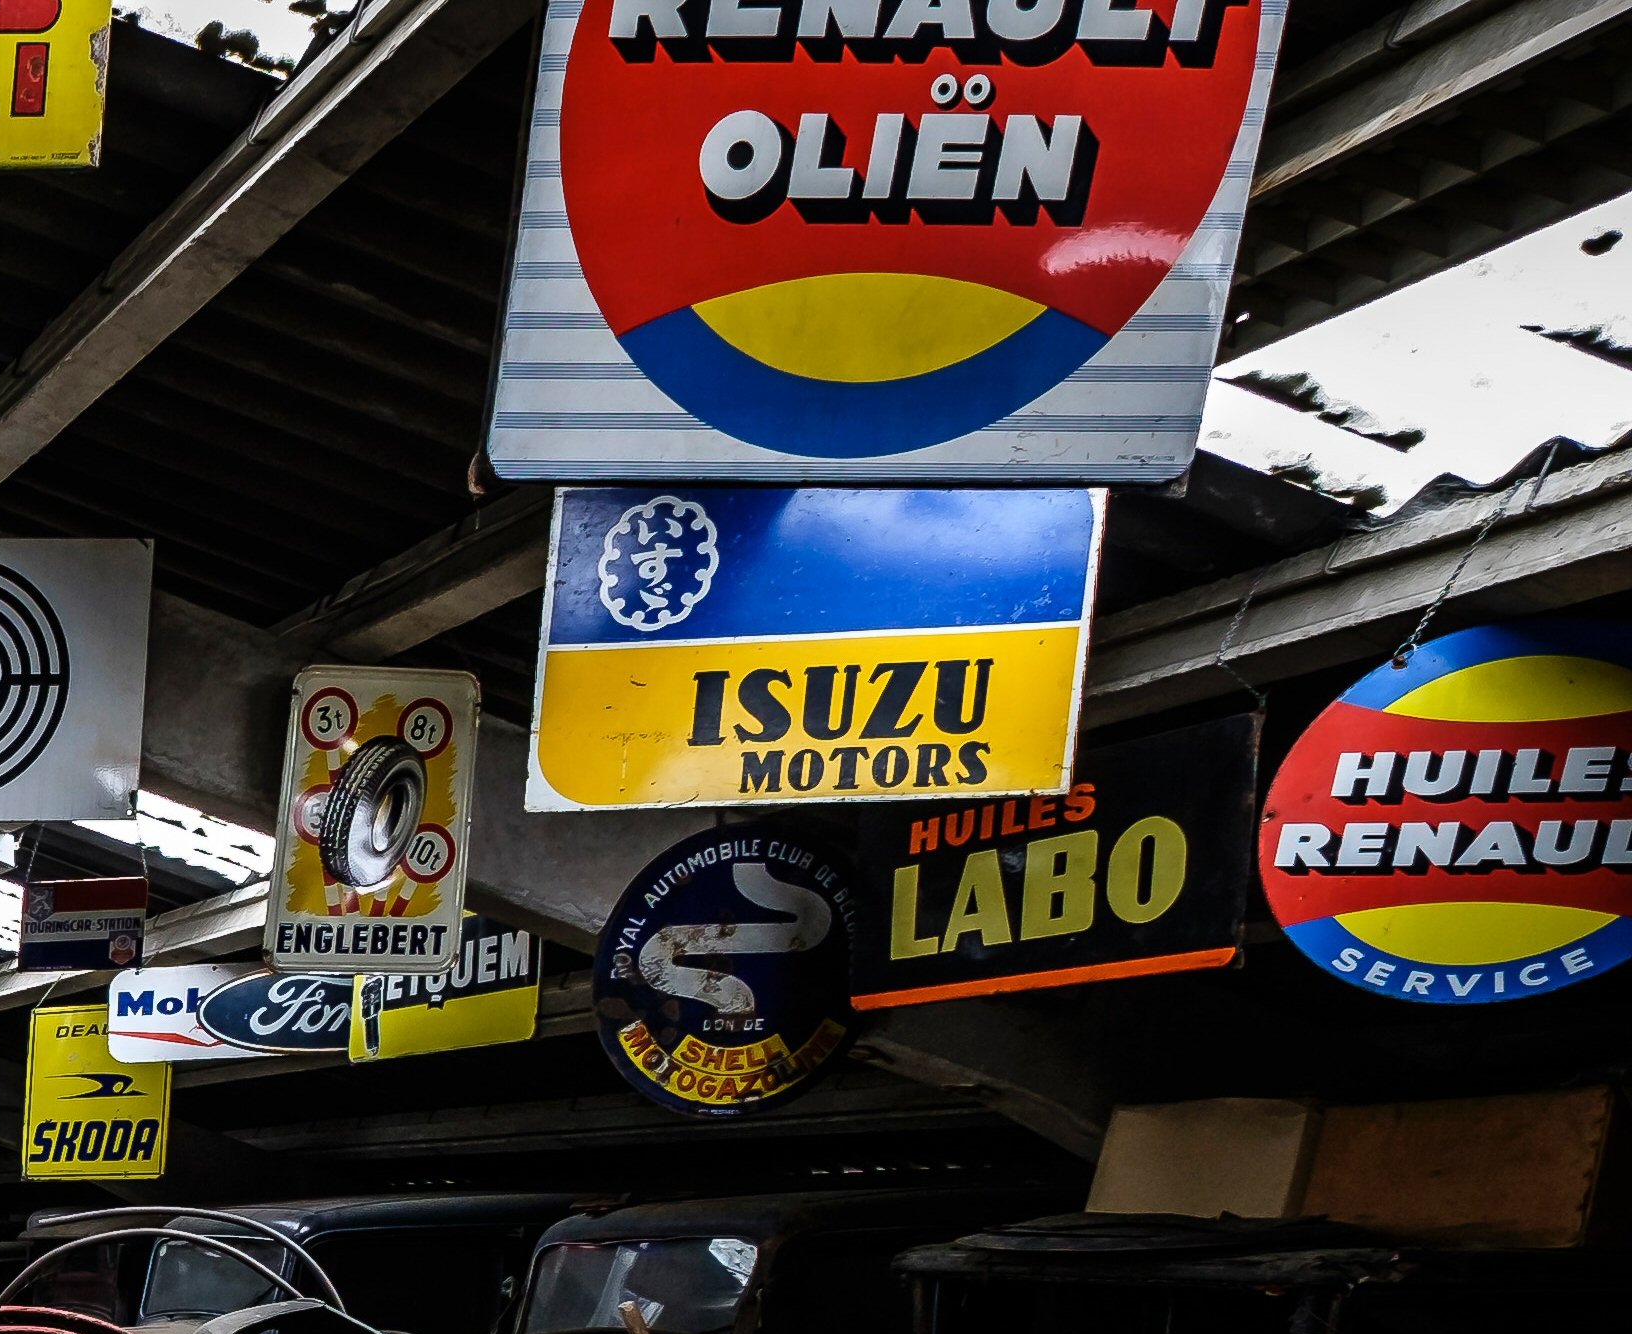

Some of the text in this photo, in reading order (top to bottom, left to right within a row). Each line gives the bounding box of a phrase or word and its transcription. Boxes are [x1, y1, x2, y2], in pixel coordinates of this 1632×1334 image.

[699, 73, 1088, 205] OLIËN
[316, 705, 345, 734] 3t
[689, 658, 994, 747] ISUZU
[410, 714, 437, 745] 8t
[740, 741, 992, 794] MOTORS
[1330, 746, 1632, 797] HUILE
[909, 783, 1096, 856] HUILES
[1274, 819, 1632, 867] RENAUL
[409, 835, 443, 872] 10t
[610, 917, 647, 981] ROYAL
[643, 839, 762, 909] AUTOMOBILE
[767, 840, 814, 870] CLUB
[813, 866, 837, 889] DE
[891, 815, 1187, 960] LABO
[275, 922, 449, 956] ENGLEBERT
[386, 929, 530, 1001] EUEM
[1331, 947, 1595, 997] SERVICE
[250, 975, 353, 1035] For
[743, 1017, 766, 1031] DE
[679, 1039, 785, 1072] SHELL
[29, 1117, 160, 1163] ŠKODA
